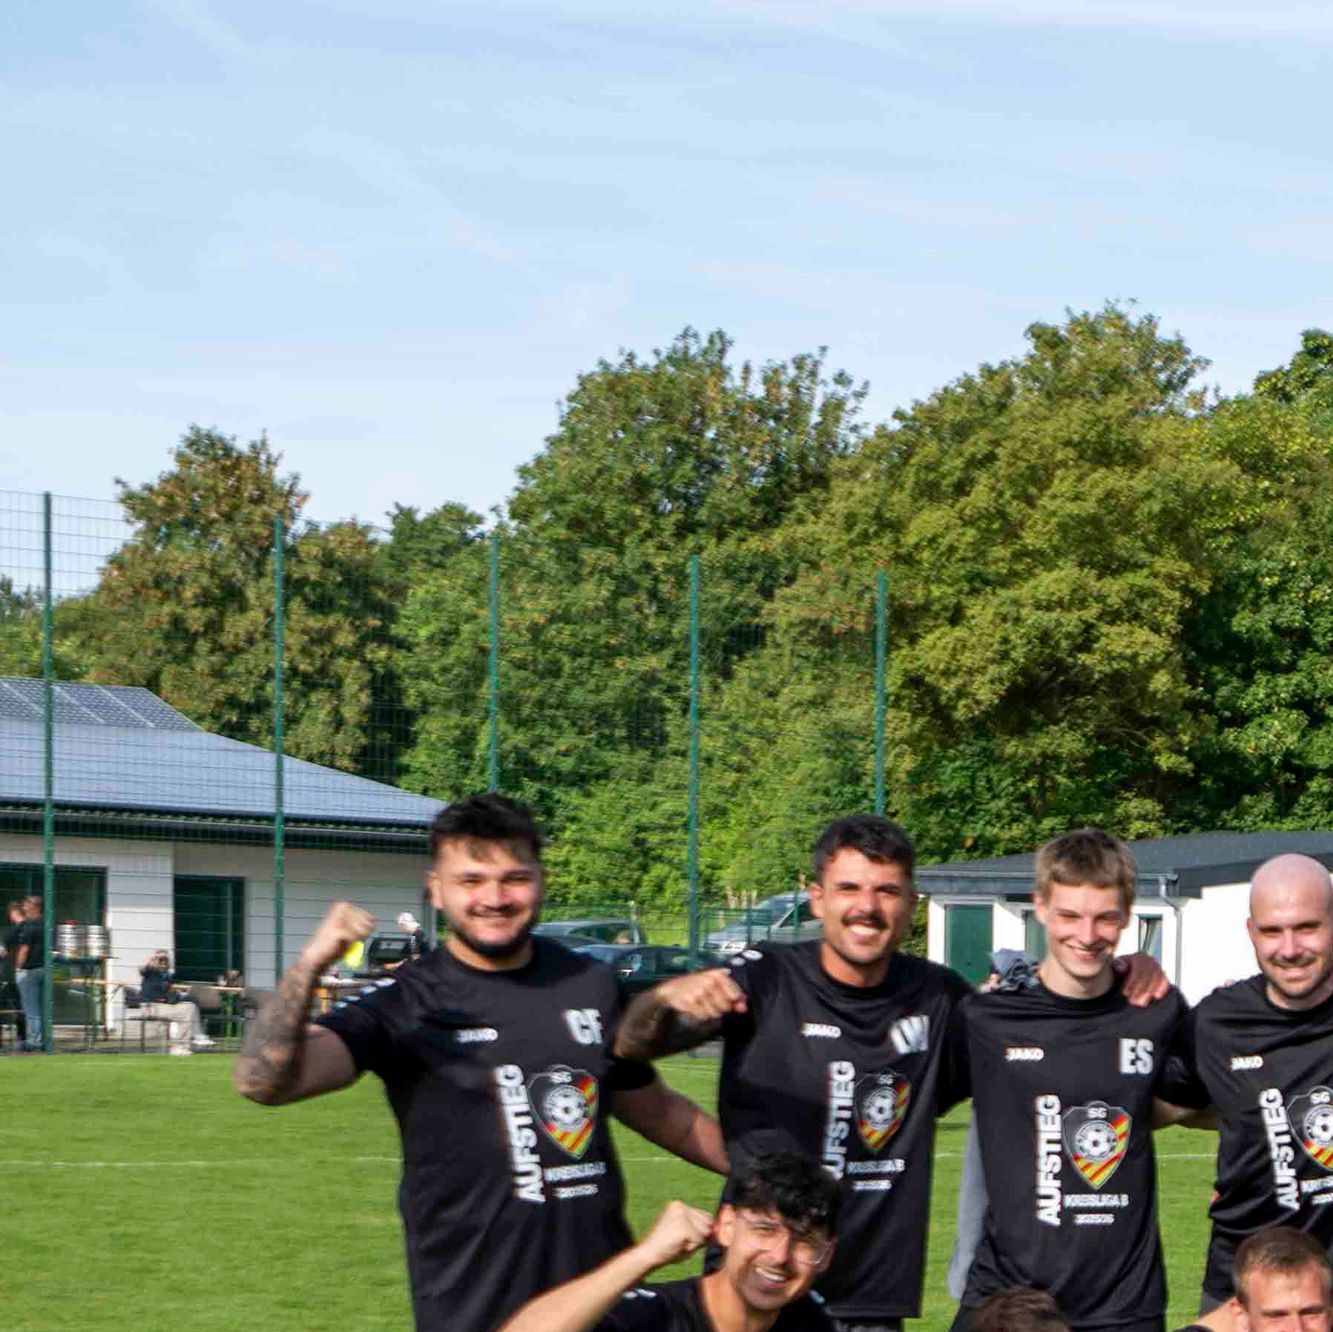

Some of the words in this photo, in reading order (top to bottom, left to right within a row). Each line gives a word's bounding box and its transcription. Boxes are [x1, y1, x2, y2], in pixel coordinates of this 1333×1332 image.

[1119, 1038, 1154, 1075] ES
[1086, 1107, 1108, 1119] SG
[1259, 1088, 1300, 1211] AUFSTIEG
[1036, 1094, 1062, 1227] AUFSTIEG
